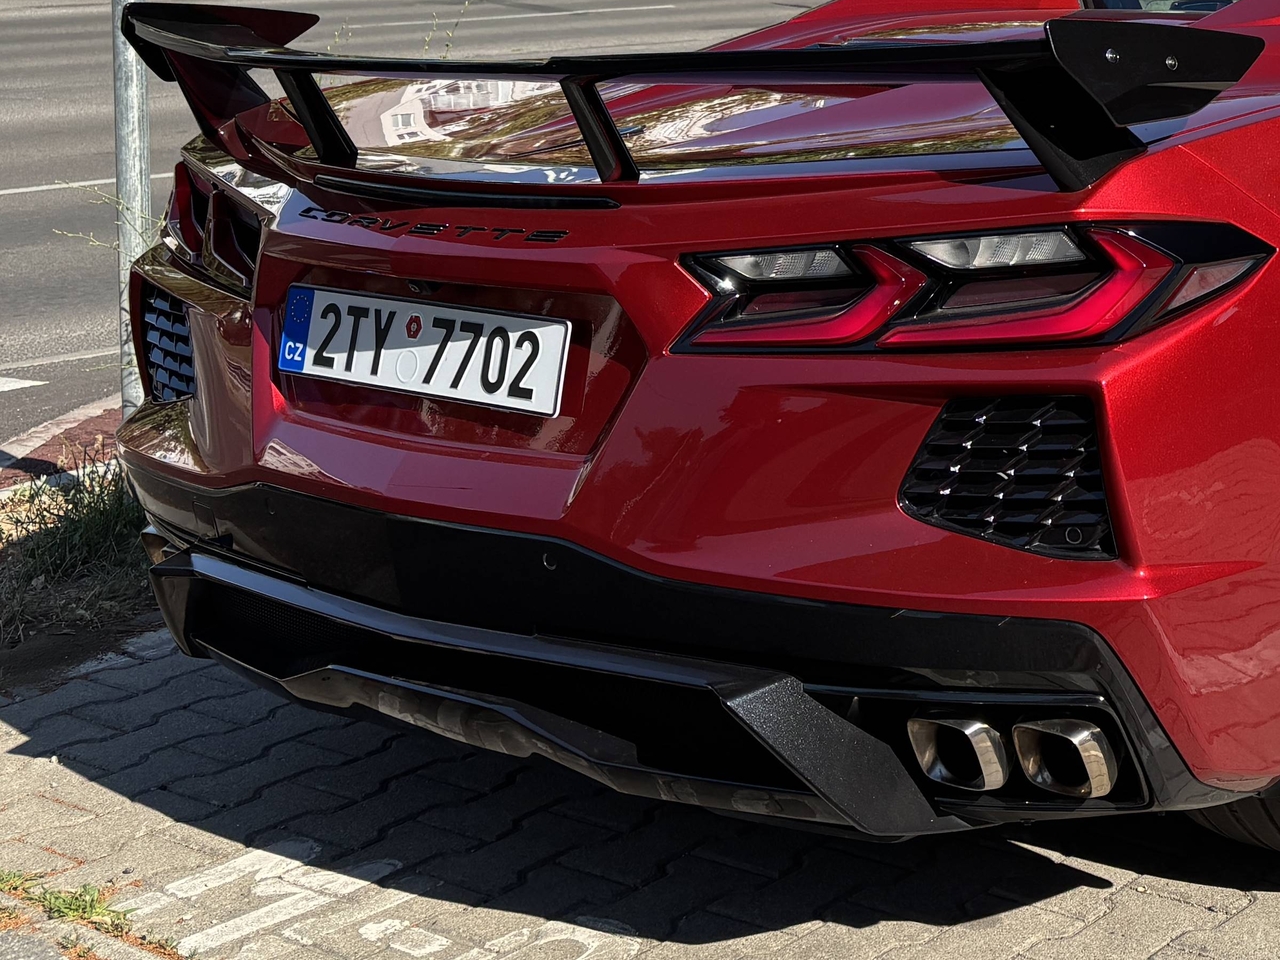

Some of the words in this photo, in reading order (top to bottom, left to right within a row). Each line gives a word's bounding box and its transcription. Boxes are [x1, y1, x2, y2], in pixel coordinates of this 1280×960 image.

[299, 206, 570, 243] CORVETTE
[284, 341, 303, 361] CZ
[312, 302, 397, 376] 2TY
[422, 316, 540, 401] 7702
